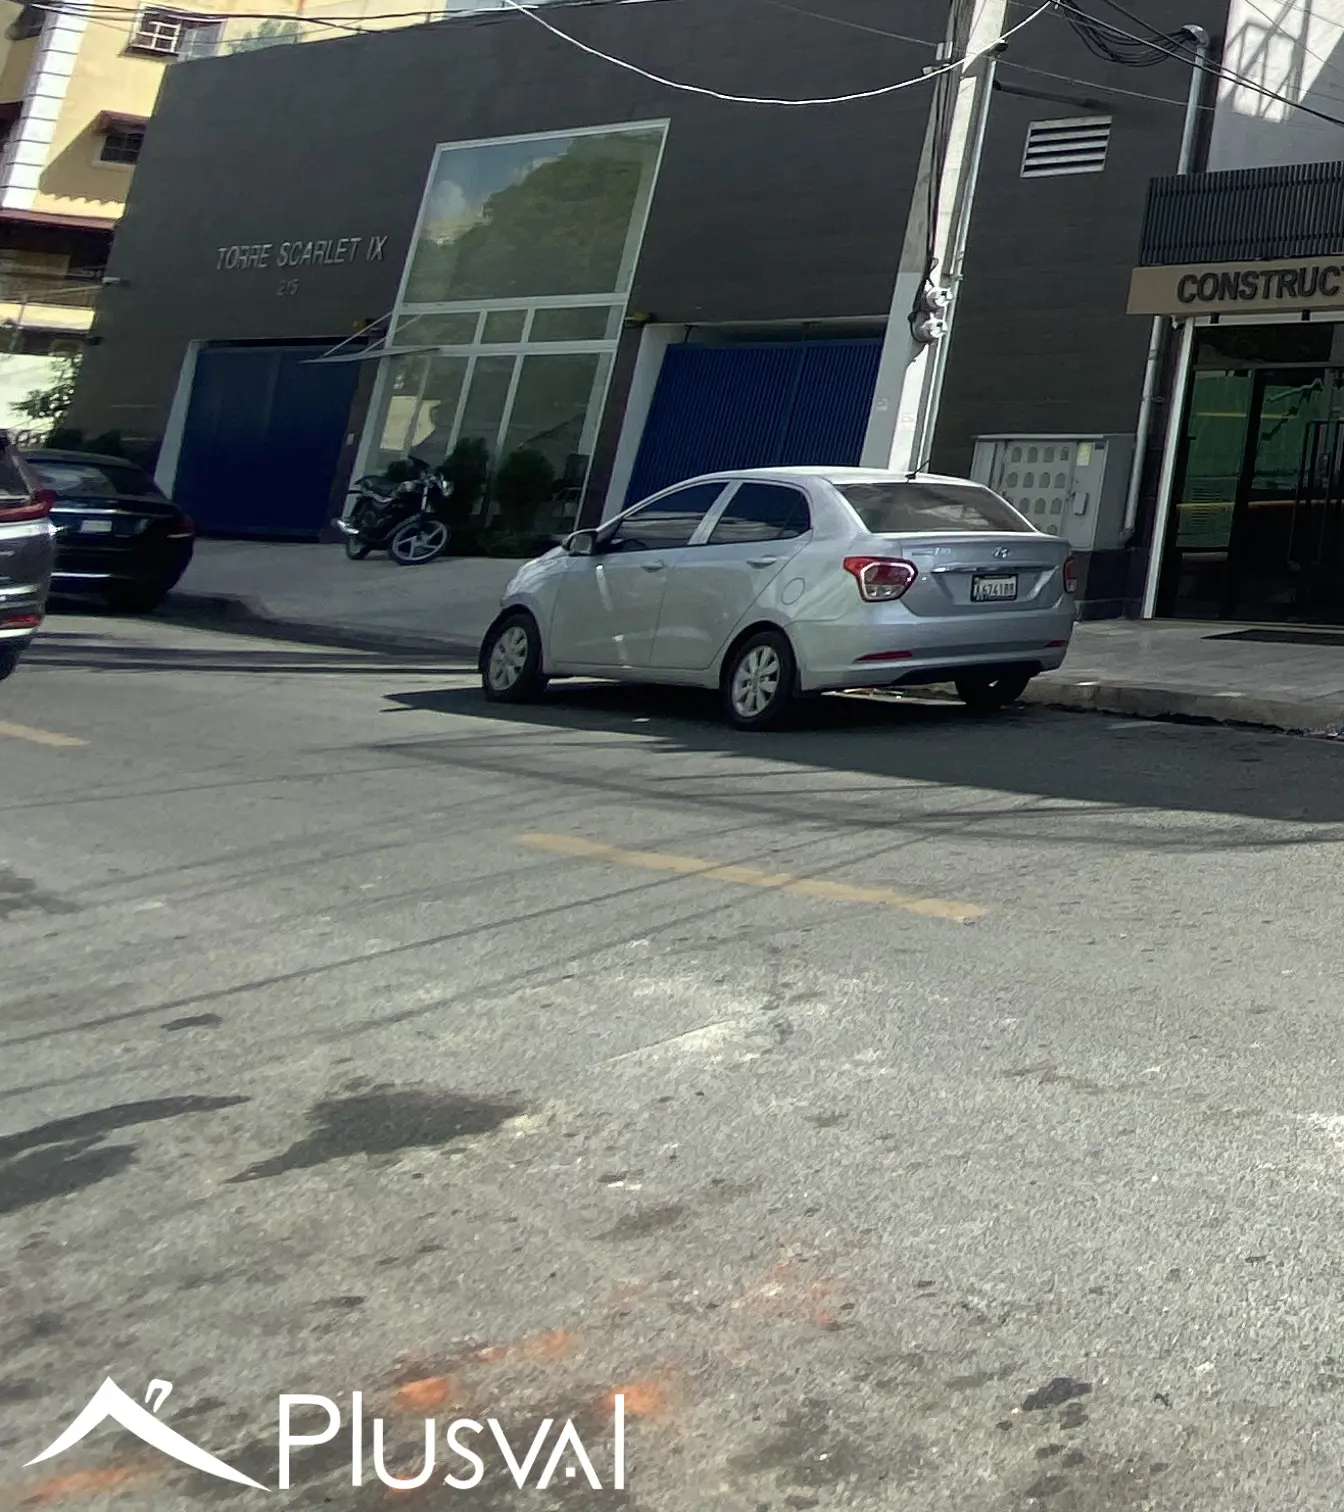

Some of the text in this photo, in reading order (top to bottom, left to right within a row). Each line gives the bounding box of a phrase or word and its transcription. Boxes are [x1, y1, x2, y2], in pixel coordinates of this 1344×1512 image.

[216, 235, 388, 270] TORRE SCARLET IX
